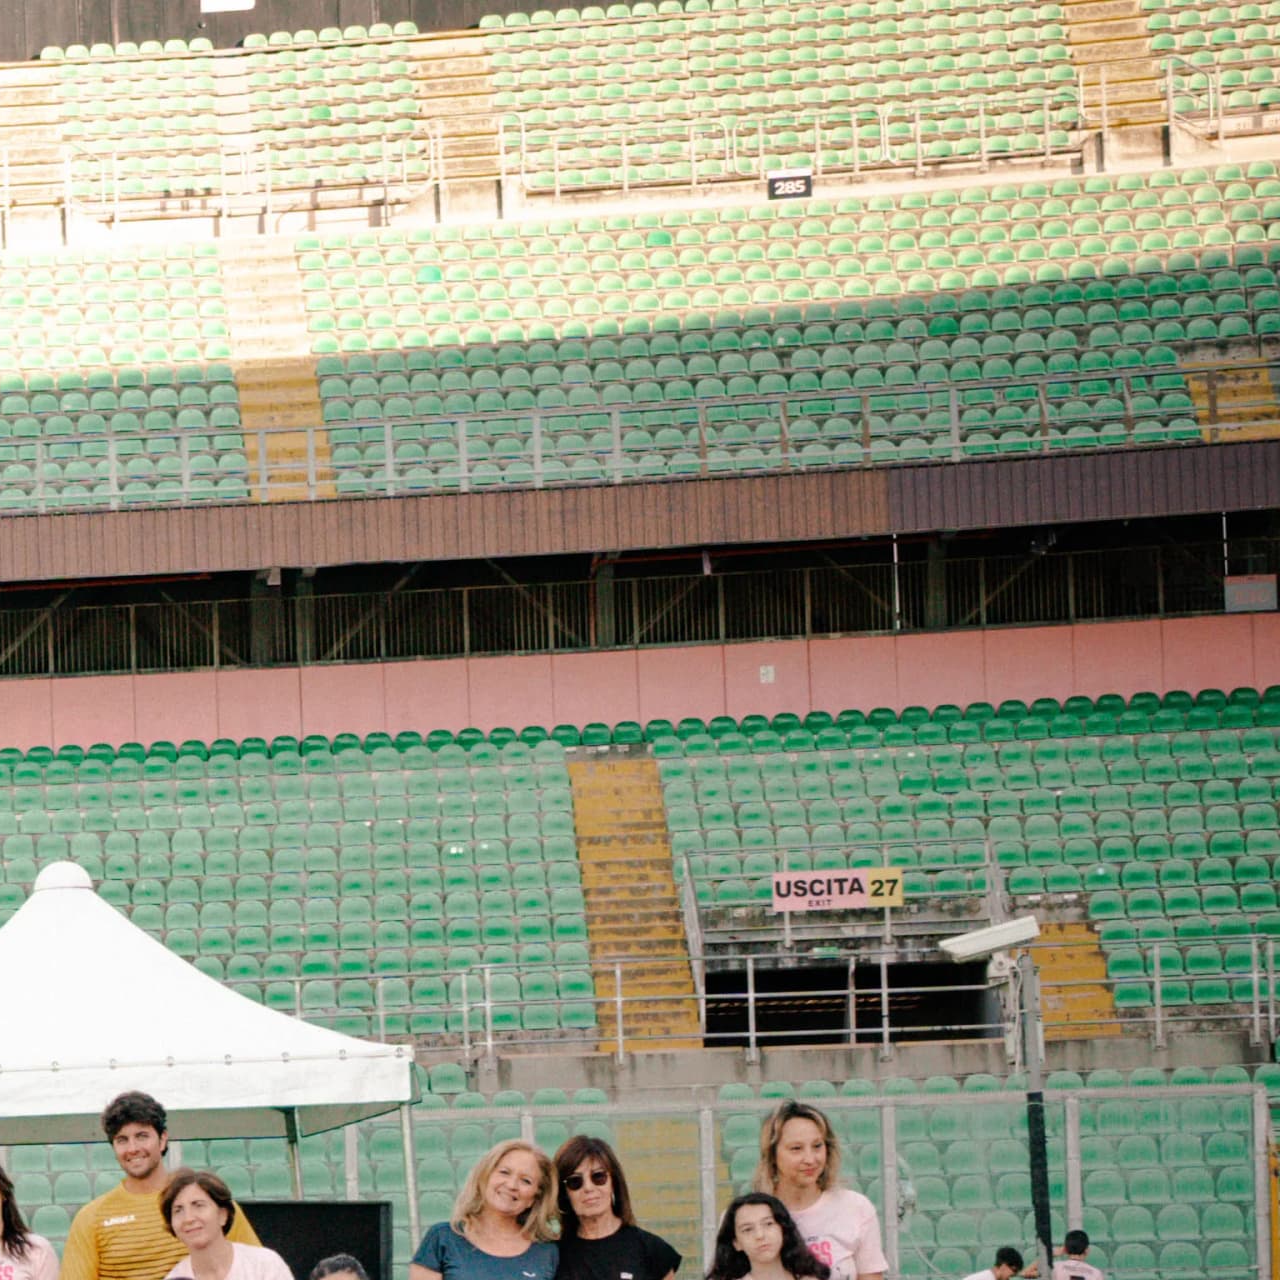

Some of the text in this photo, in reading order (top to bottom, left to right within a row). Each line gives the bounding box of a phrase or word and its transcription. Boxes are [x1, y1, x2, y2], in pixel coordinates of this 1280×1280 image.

[774, 180, 806, 195] 285
[775, 877, 899, 898] USCITA 27
[808, 899, 832, 907] EXIT
